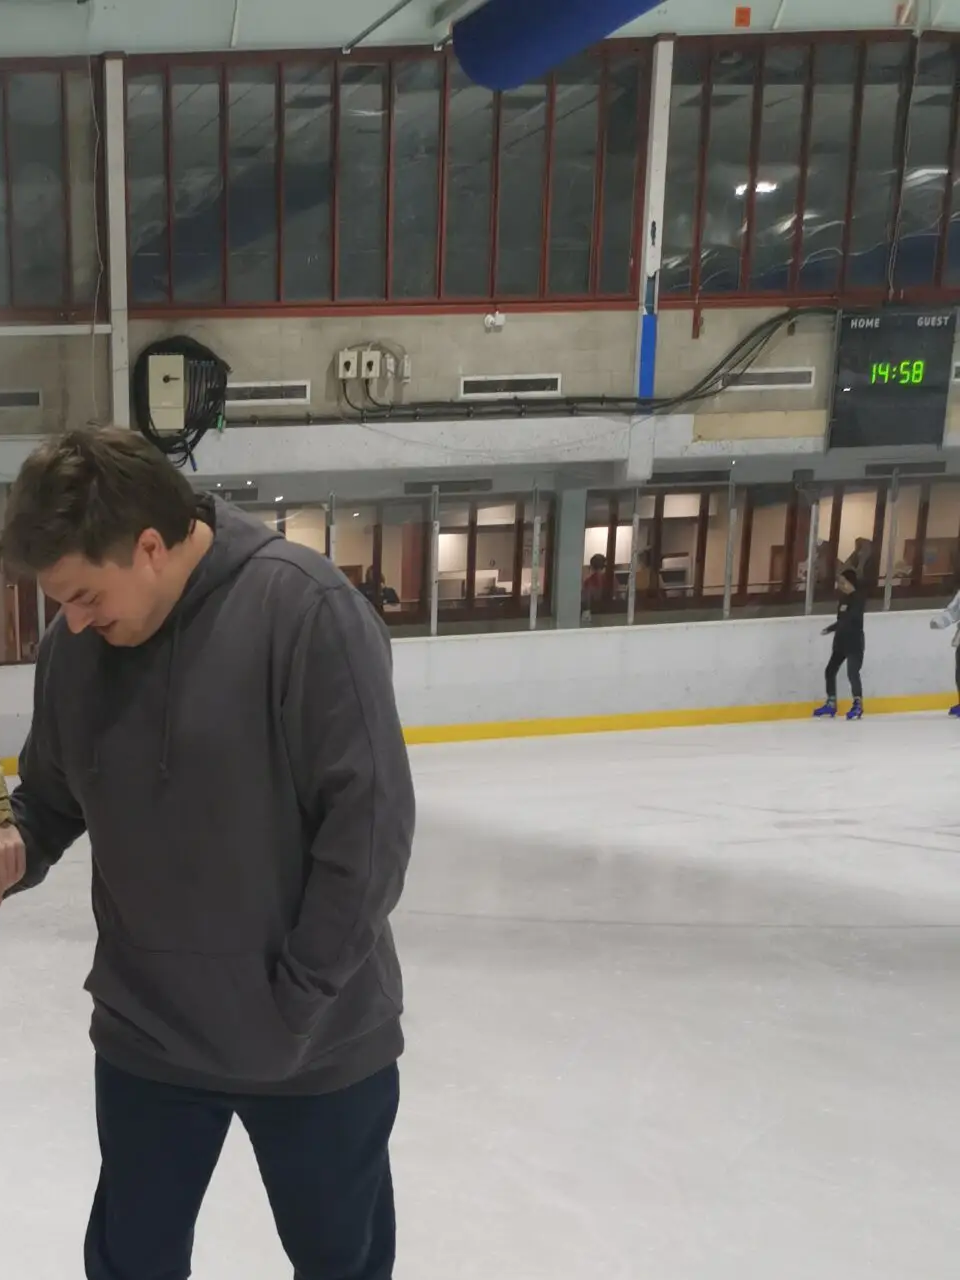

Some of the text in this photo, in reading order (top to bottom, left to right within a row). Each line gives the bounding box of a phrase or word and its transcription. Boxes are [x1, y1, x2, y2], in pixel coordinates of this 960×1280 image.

[850, 317, 881, 329] HOME
[917, 316, 950, 327] GUEST
[871, 360, 925, 384] 14:58
